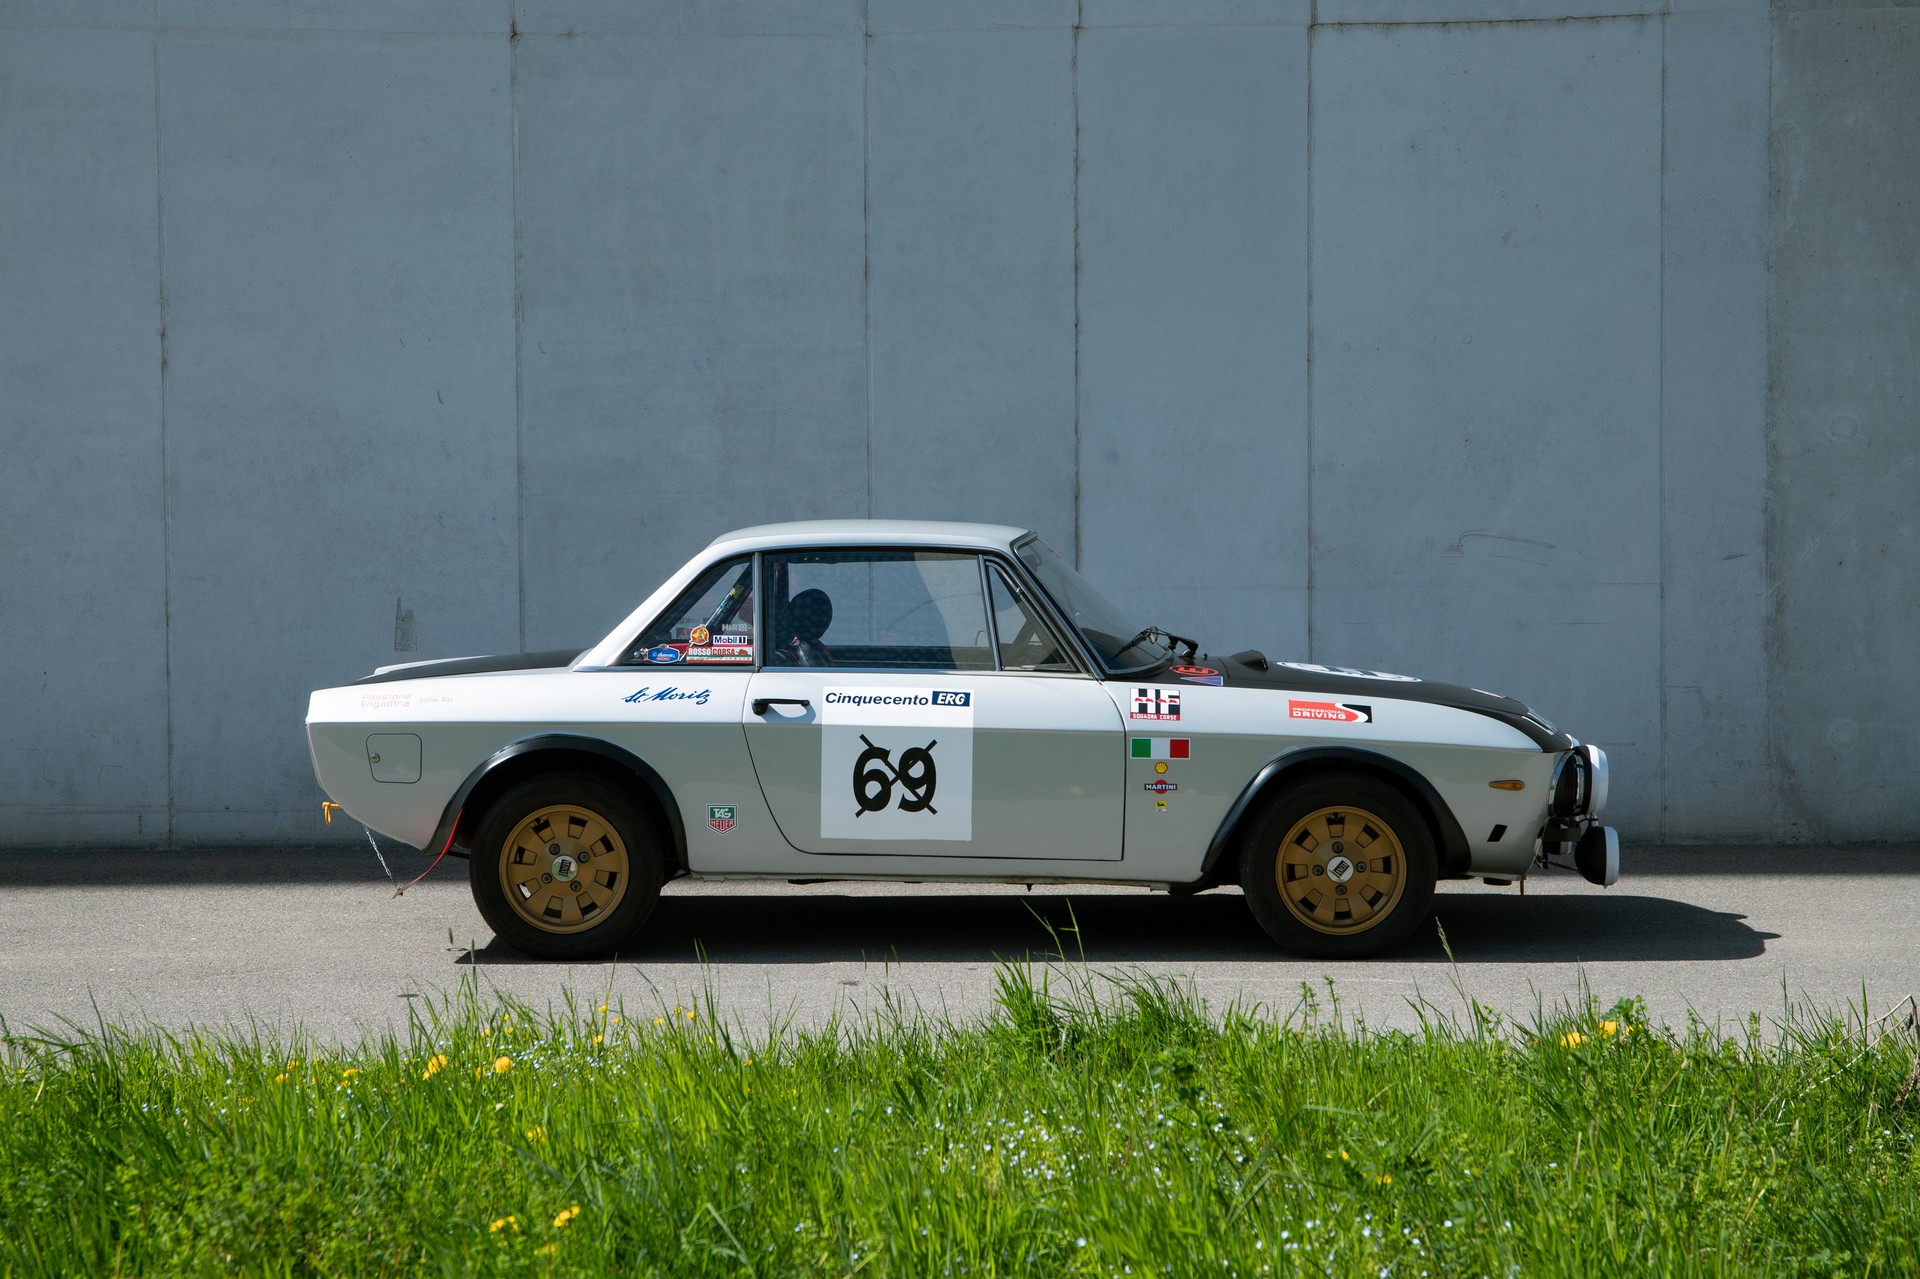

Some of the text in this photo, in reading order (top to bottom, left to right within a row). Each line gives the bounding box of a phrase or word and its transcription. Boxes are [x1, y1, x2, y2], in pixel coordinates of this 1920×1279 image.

[714, 636, 738, 644] Mobil
[688, 647, 736, 656] ROSSO CORSA
[362, 693, 412, 701] Passione
[643, 686, 713, 705] Moritz
[825, 692, 966, 707] Cinquecento ERG
[1130, 688, 1180, 713] HF
[360, 700, 411, 709] Engadina
[1292, 707, 1346, 715] PROFESSIONAL
[1292, 711, 1346, 720] DRIVING
[852, 746, 937, 813] 69
[712, 808, 732, 819] TAG
[710, 820, 734, 831] HEUER
